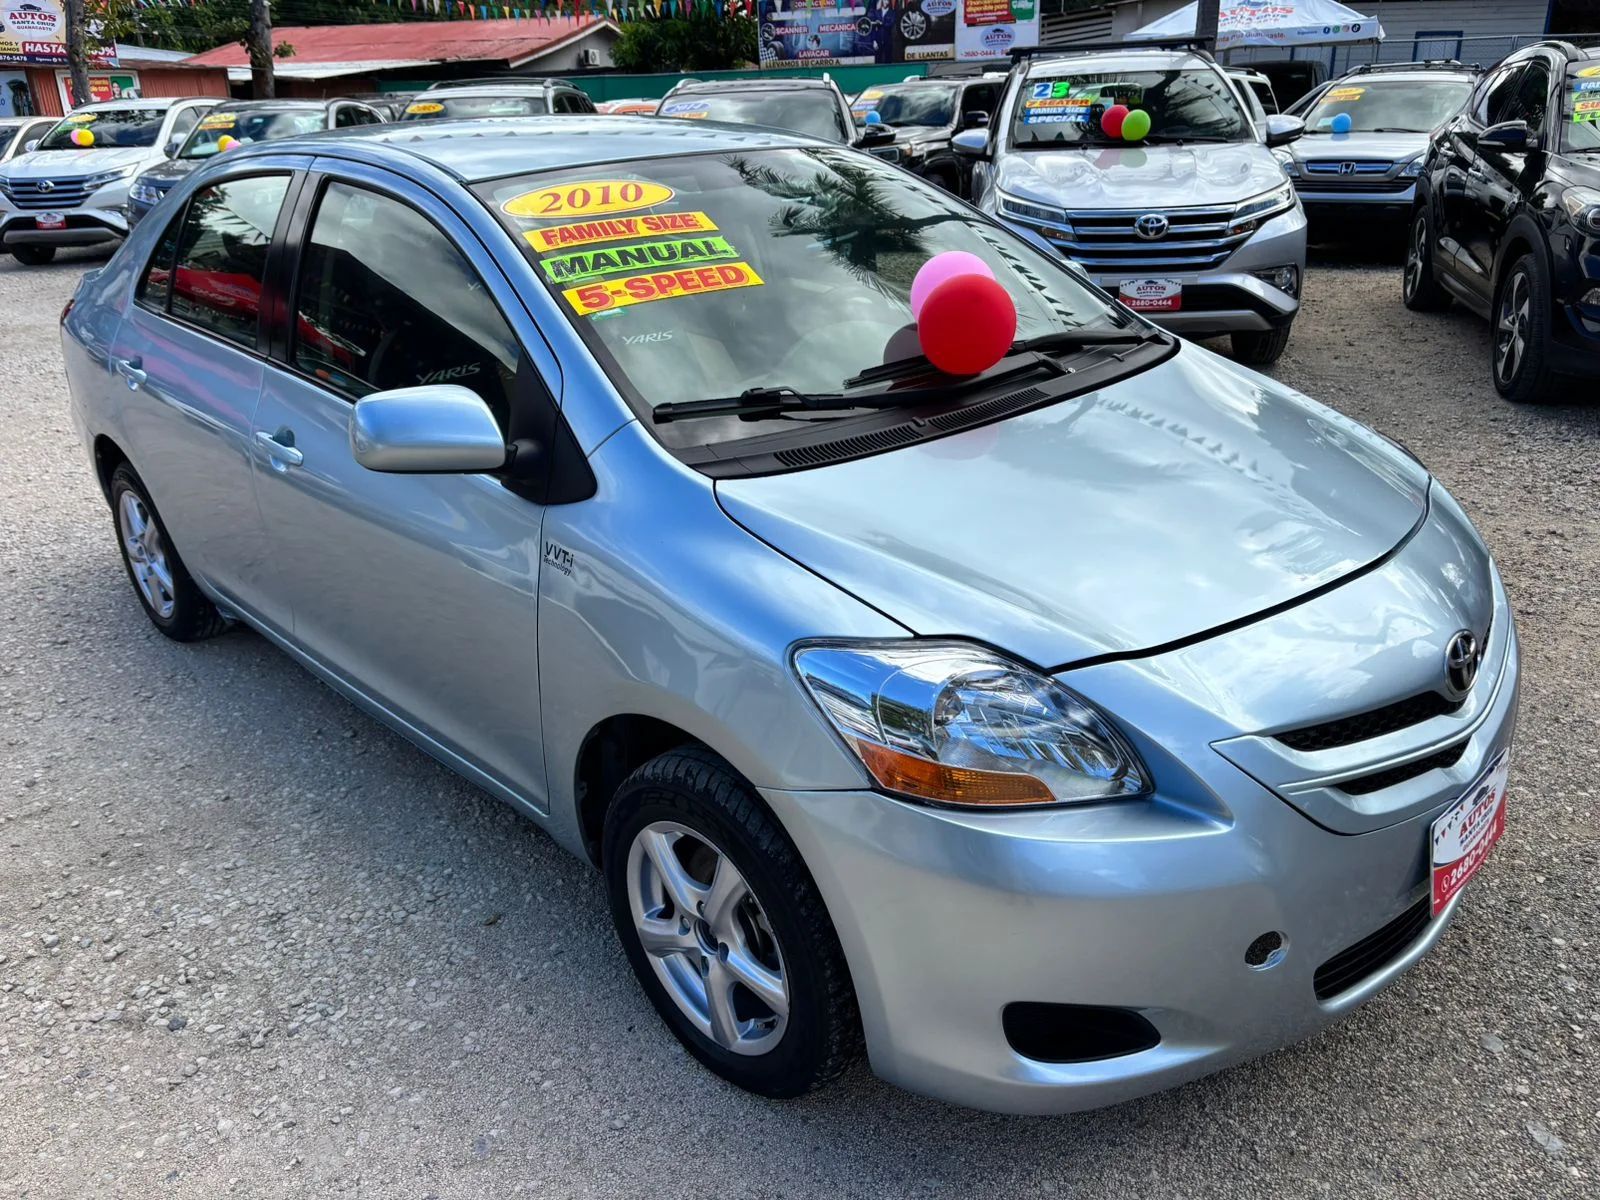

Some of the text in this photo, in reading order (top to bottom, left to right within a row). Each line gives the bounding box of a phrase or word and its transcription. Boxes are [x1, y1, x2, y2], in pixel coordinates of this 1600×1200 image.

[9, 12, 57, 22] AUTOS
[775, 26, 808, 35] SCANNER
[25, 42, 67, 54] HASTA
[1038, 99, 1090, 107] SEATER
[1065, 106, 1086, 114] SIZE
[1028, 115, 1085, 124] SPECIAL
[539, 183, 644, 214] 2010
[540, 213, 702, 248] FAMILY SIZE
[550, 239, 730, 279] MANUAL
[576, 265, 749, 309] 5-SPEED
[545, 541, 574, 567] VVT-i
[1459, 787, 1496, 839] AUTOS
